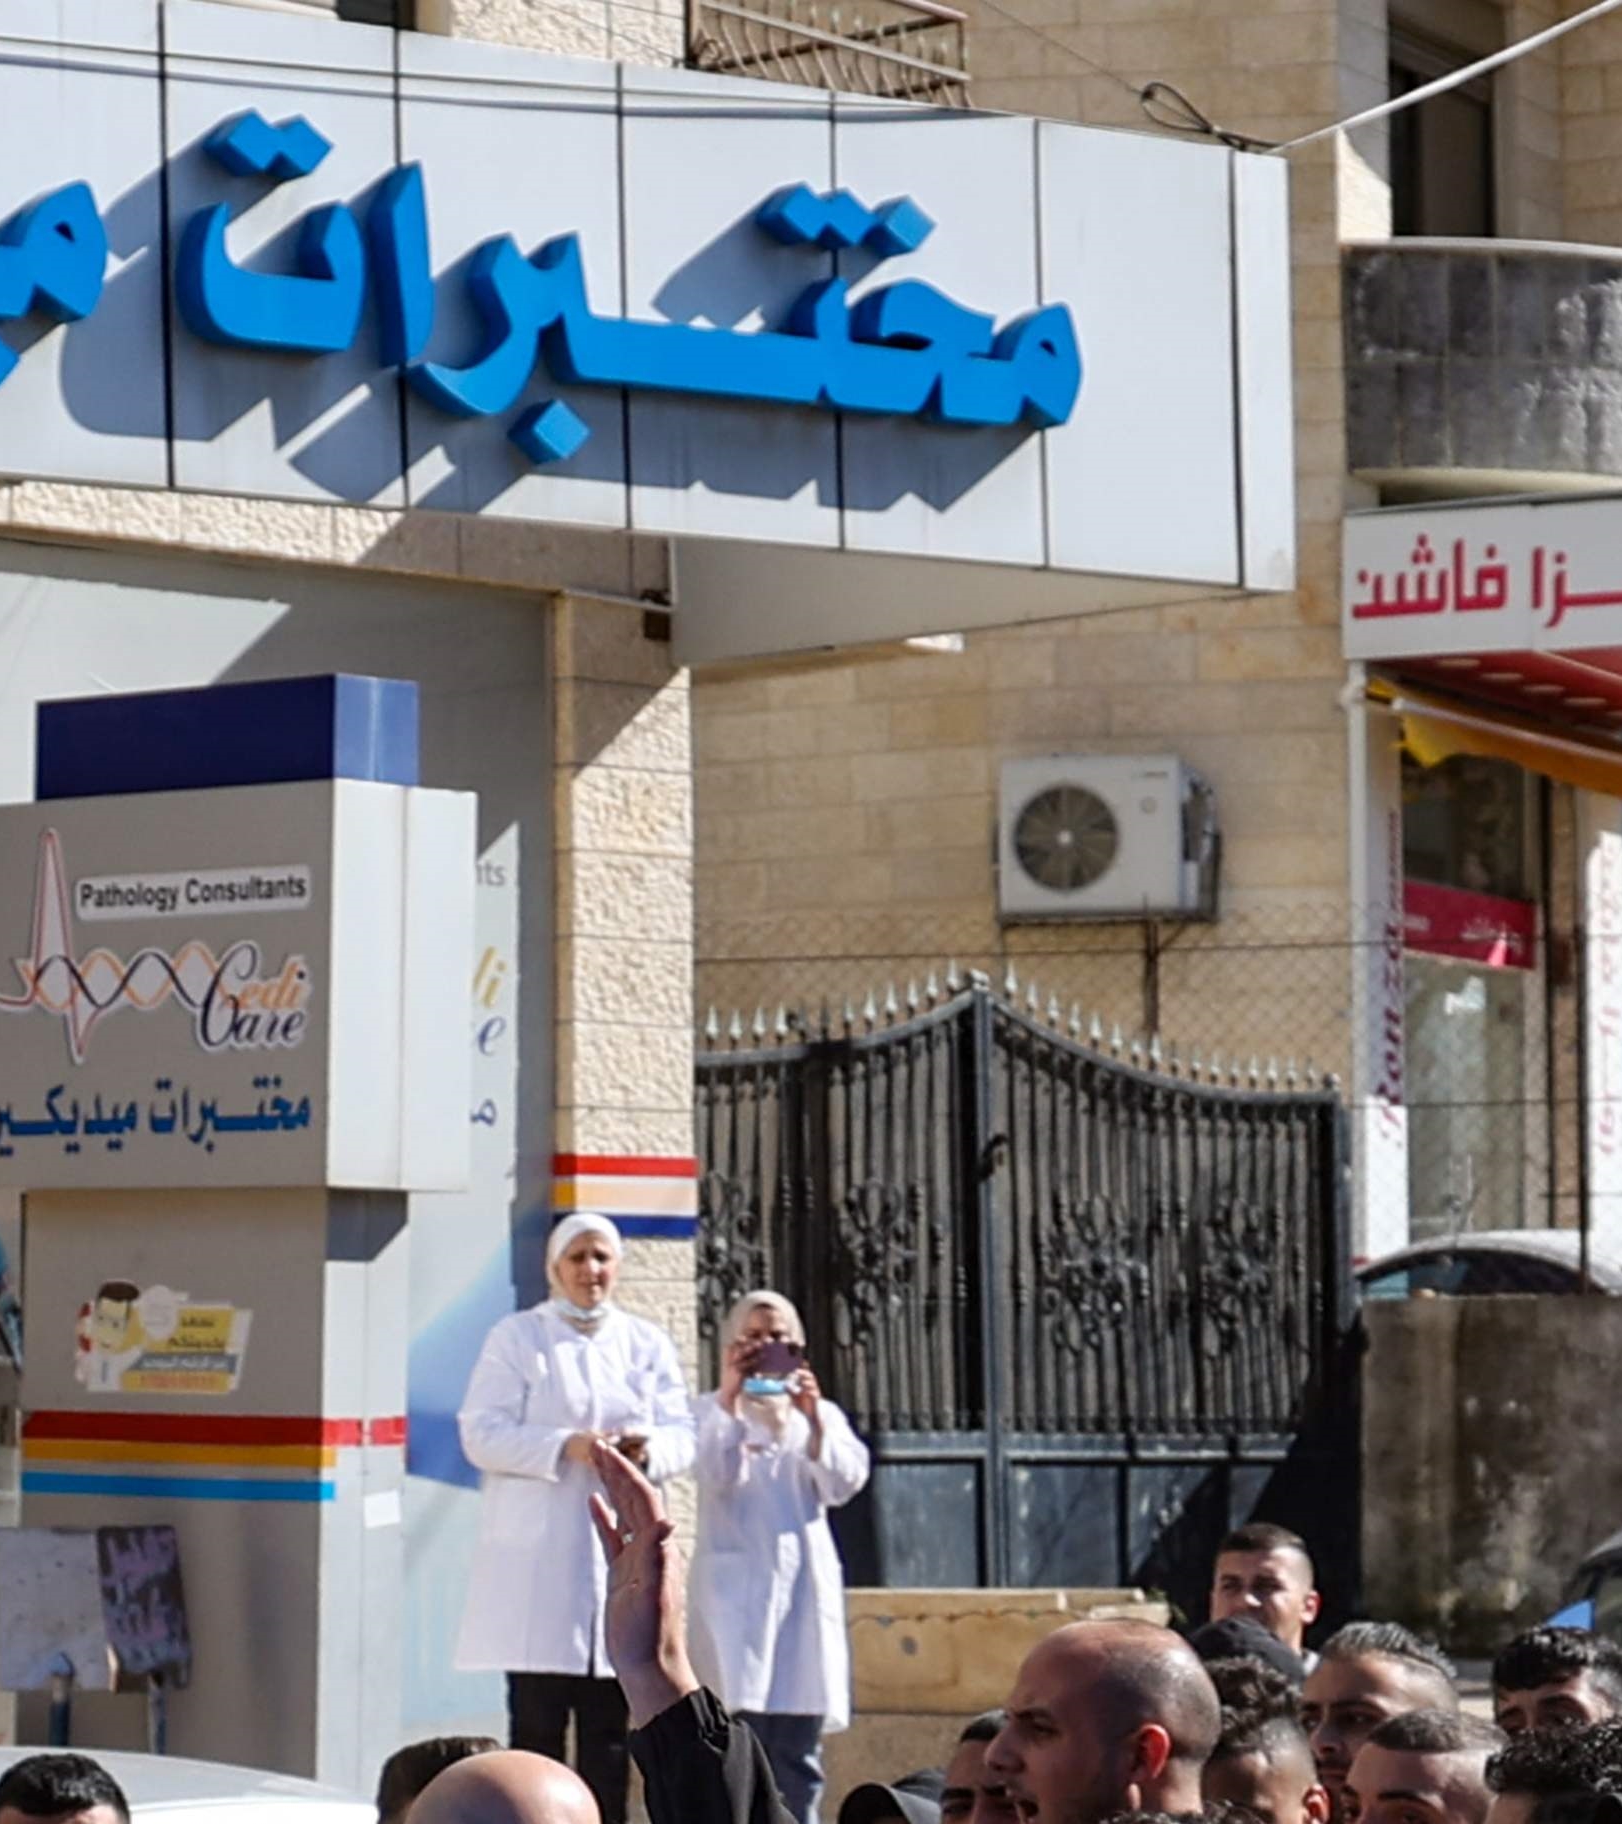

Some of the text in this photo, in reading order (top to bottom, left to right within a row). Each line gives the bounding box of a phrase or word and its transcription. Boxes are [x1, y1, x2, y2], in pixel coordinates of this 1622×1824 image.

[174, 110, 1084, 466] مختبرات
[1352, 532, 1509, 620] فاشن
[80, 874, 308, 912] Pathology Consultants
[147, 1075, 313, 1154] مختبرات
